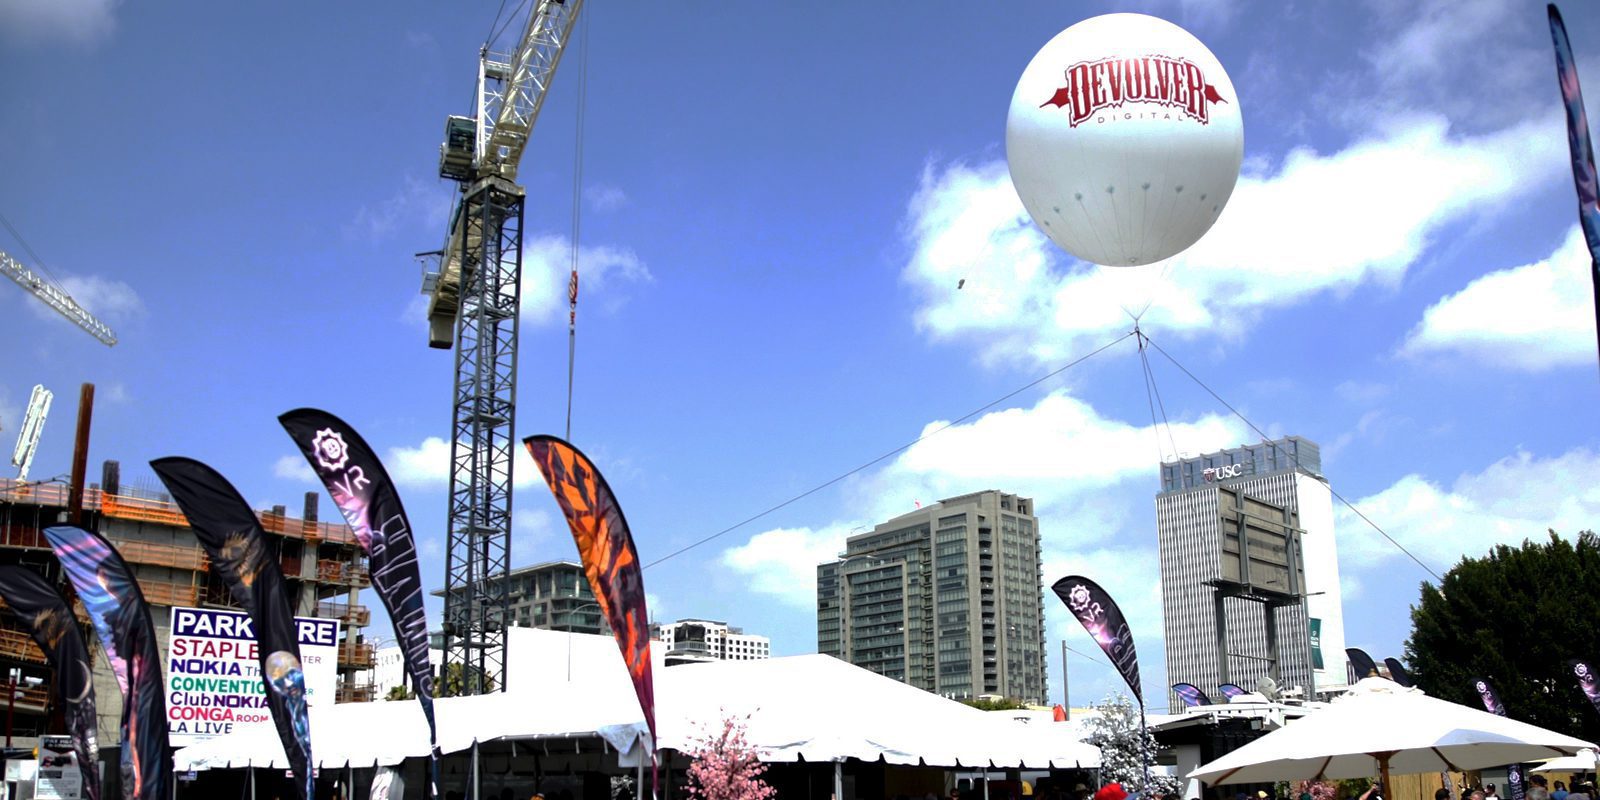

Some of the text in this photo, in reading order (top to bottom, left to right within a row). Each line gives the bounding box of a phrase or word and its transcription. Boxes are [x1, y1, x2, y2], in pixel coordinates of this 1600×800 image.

[1067, 55, 1207, 123] DEVOLVER
[1097, 111, 1184, 124] DIGITAL
[333, 465, 372, 497] VR
[1215, 463, 1242, 480] USC
[177, 611, 254, 638] PARK
[172, 638, 259, 660] STAPLE
[170, 658, 242, 677] NOKIA
[170, 676, 265, 695] CONVENTIO
[169, 691, 269, 709] Club NOKIA
[168, 706, 269, 723] CONGA ROOM
[168, 721, 234, 734] LA LIVE
